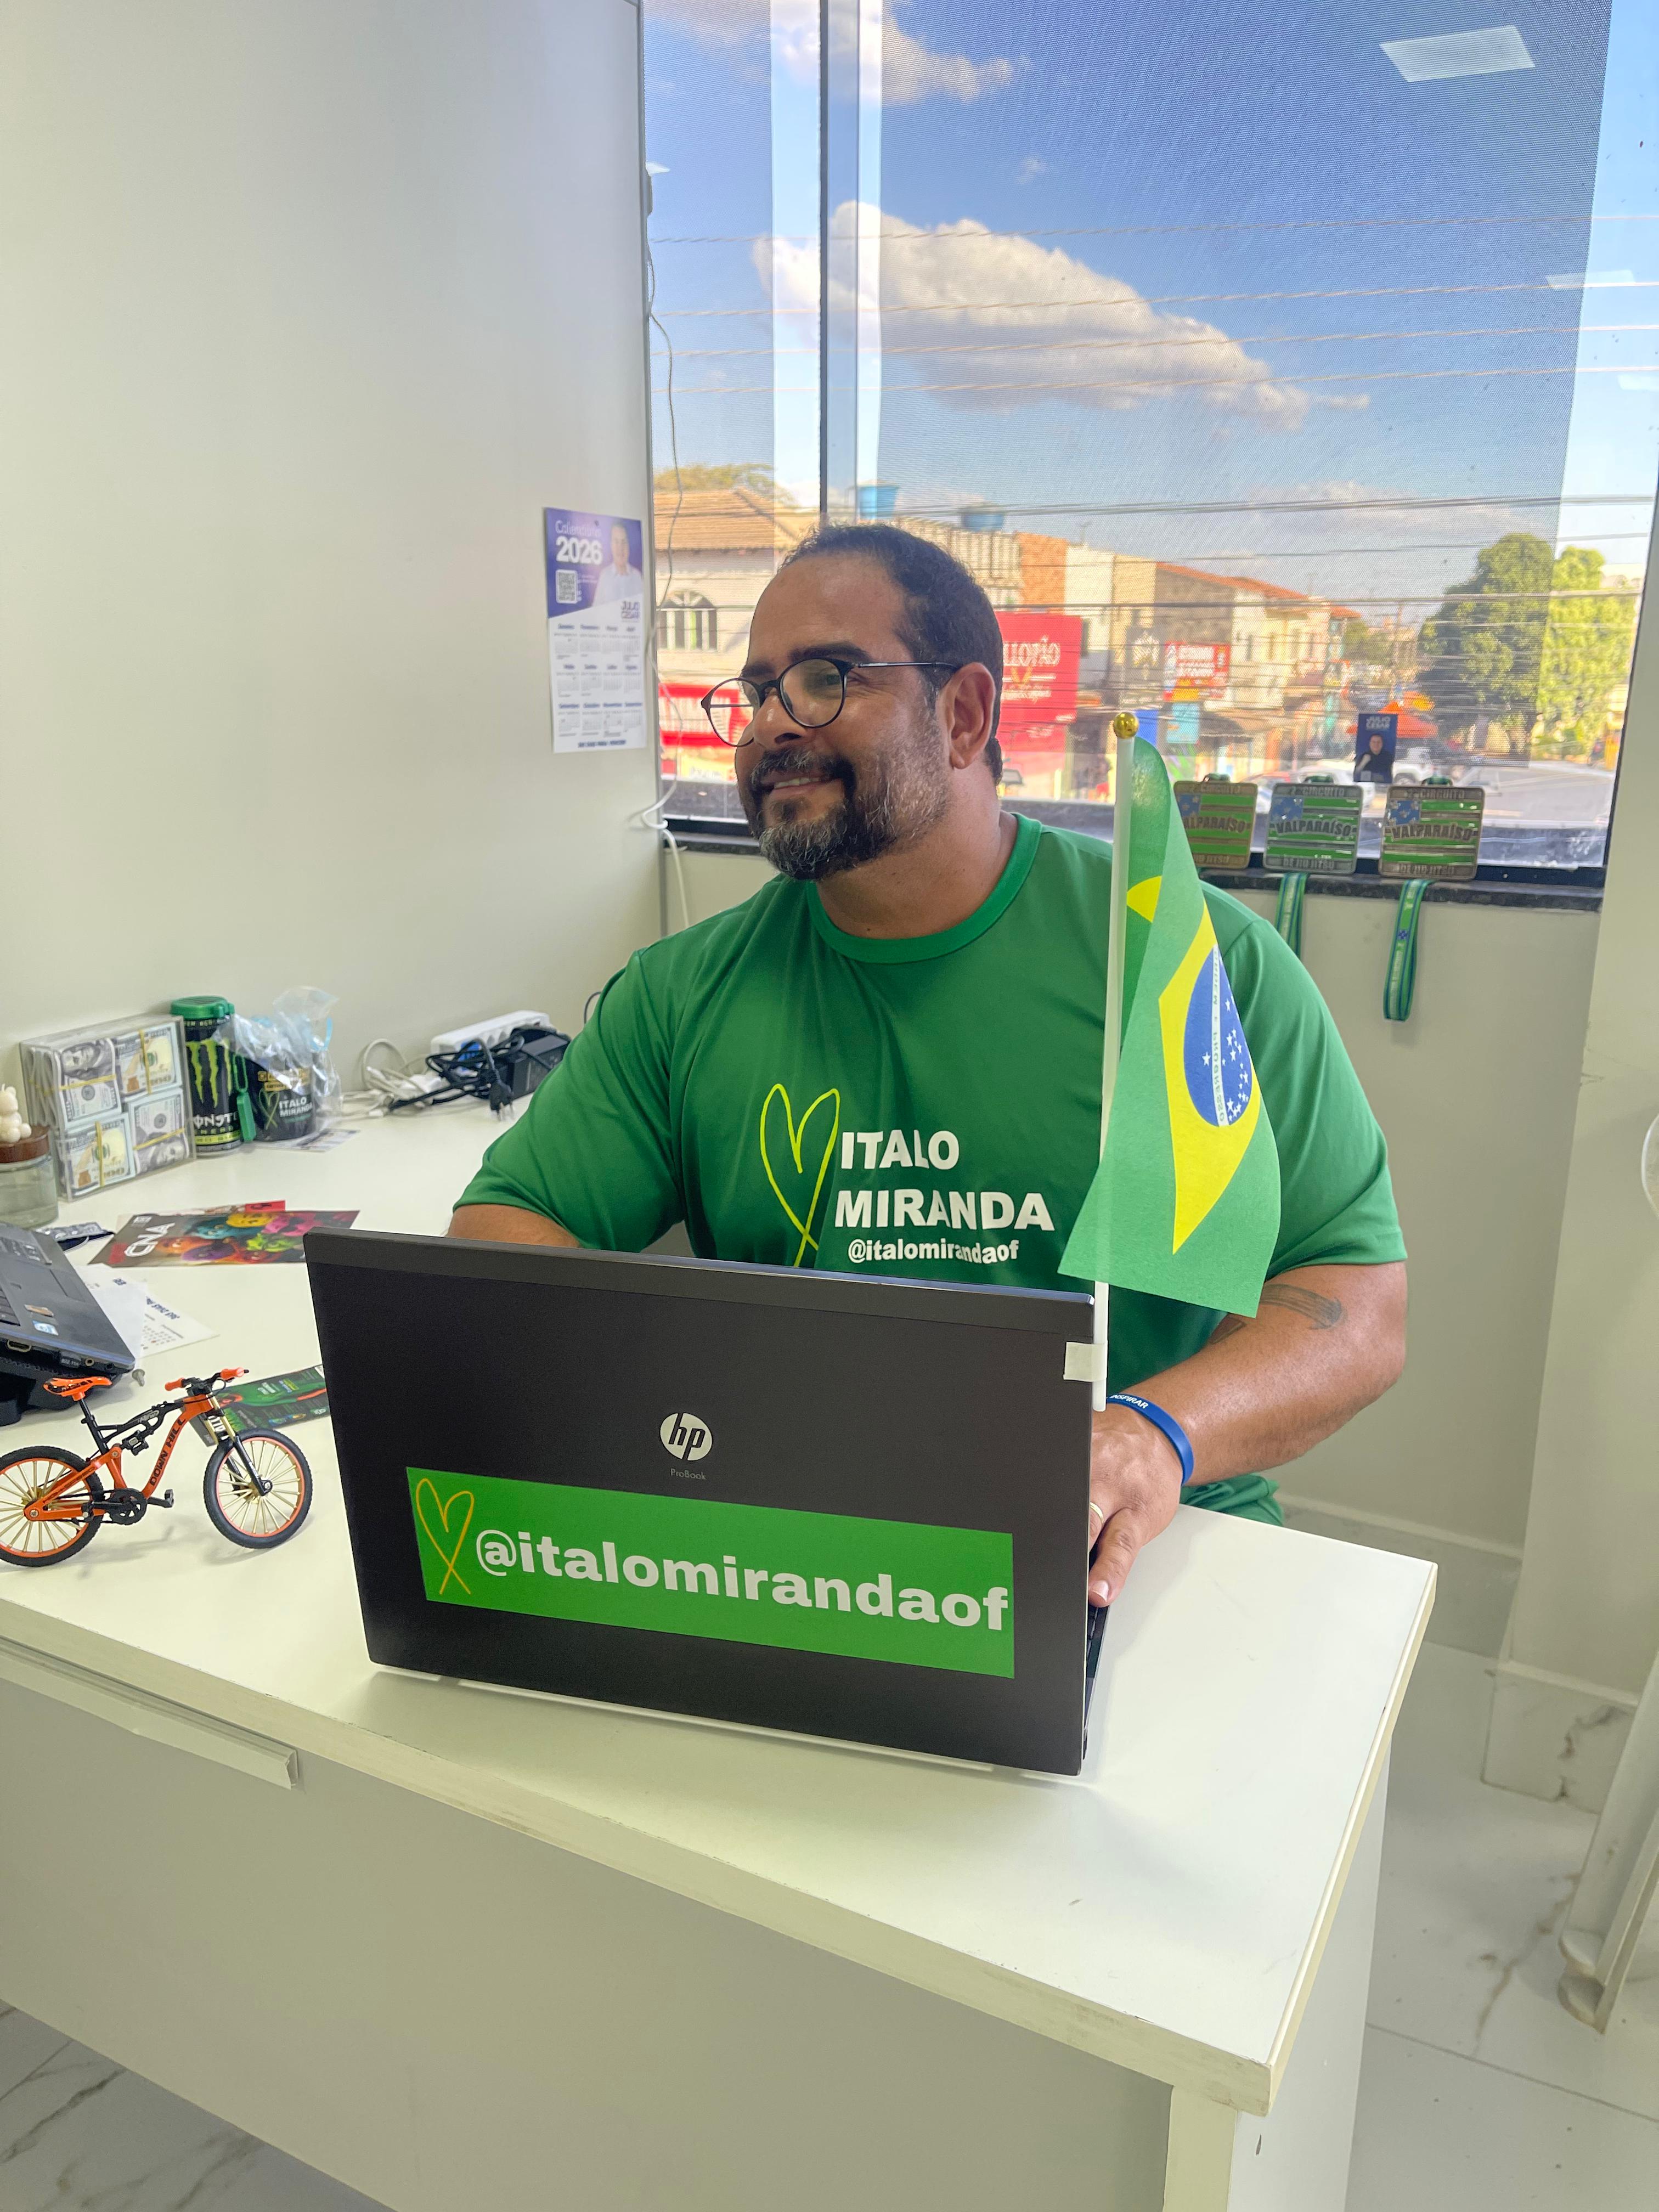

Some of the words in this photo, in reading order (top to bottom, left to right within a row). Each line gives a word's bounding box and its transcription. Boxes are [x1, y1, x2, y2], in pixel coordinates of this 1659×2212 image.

[555, 535, 602, 565] 2026
[1303, 786, 1344, 798] CIRCUITO
[1421, 788, 1465, 799] CIRCUITO
[1183, 815, 1246, 834] ALPARAÍSO
[1276, 817, 1352, 837] VALPARAÍSO
[1392, 822, 1474, 841] VALPARAÍSO
[279, 1097, 307, 1109] ITALO
[280, 1102, 313, 1117] MIRANDA
[840, 1129, 960, 1170] ITALO
[834, 1188, 1055, 1231] MIRANDA
[124, 1222, 176, 1257] CNA
[848, 1238, 1019, 1263] @italomirandaof
[1109, 1394, 1149, 1409] INSPIRAR
[166, 1418, 187, 1448] HILL
[666, 1412, 708, 1460] hp
[150, 1450, 168, 1486] DOWN
[670, 1468, 707, 1480] ProBook
[476, 1529, 1009, 1631] @italomirandaof
